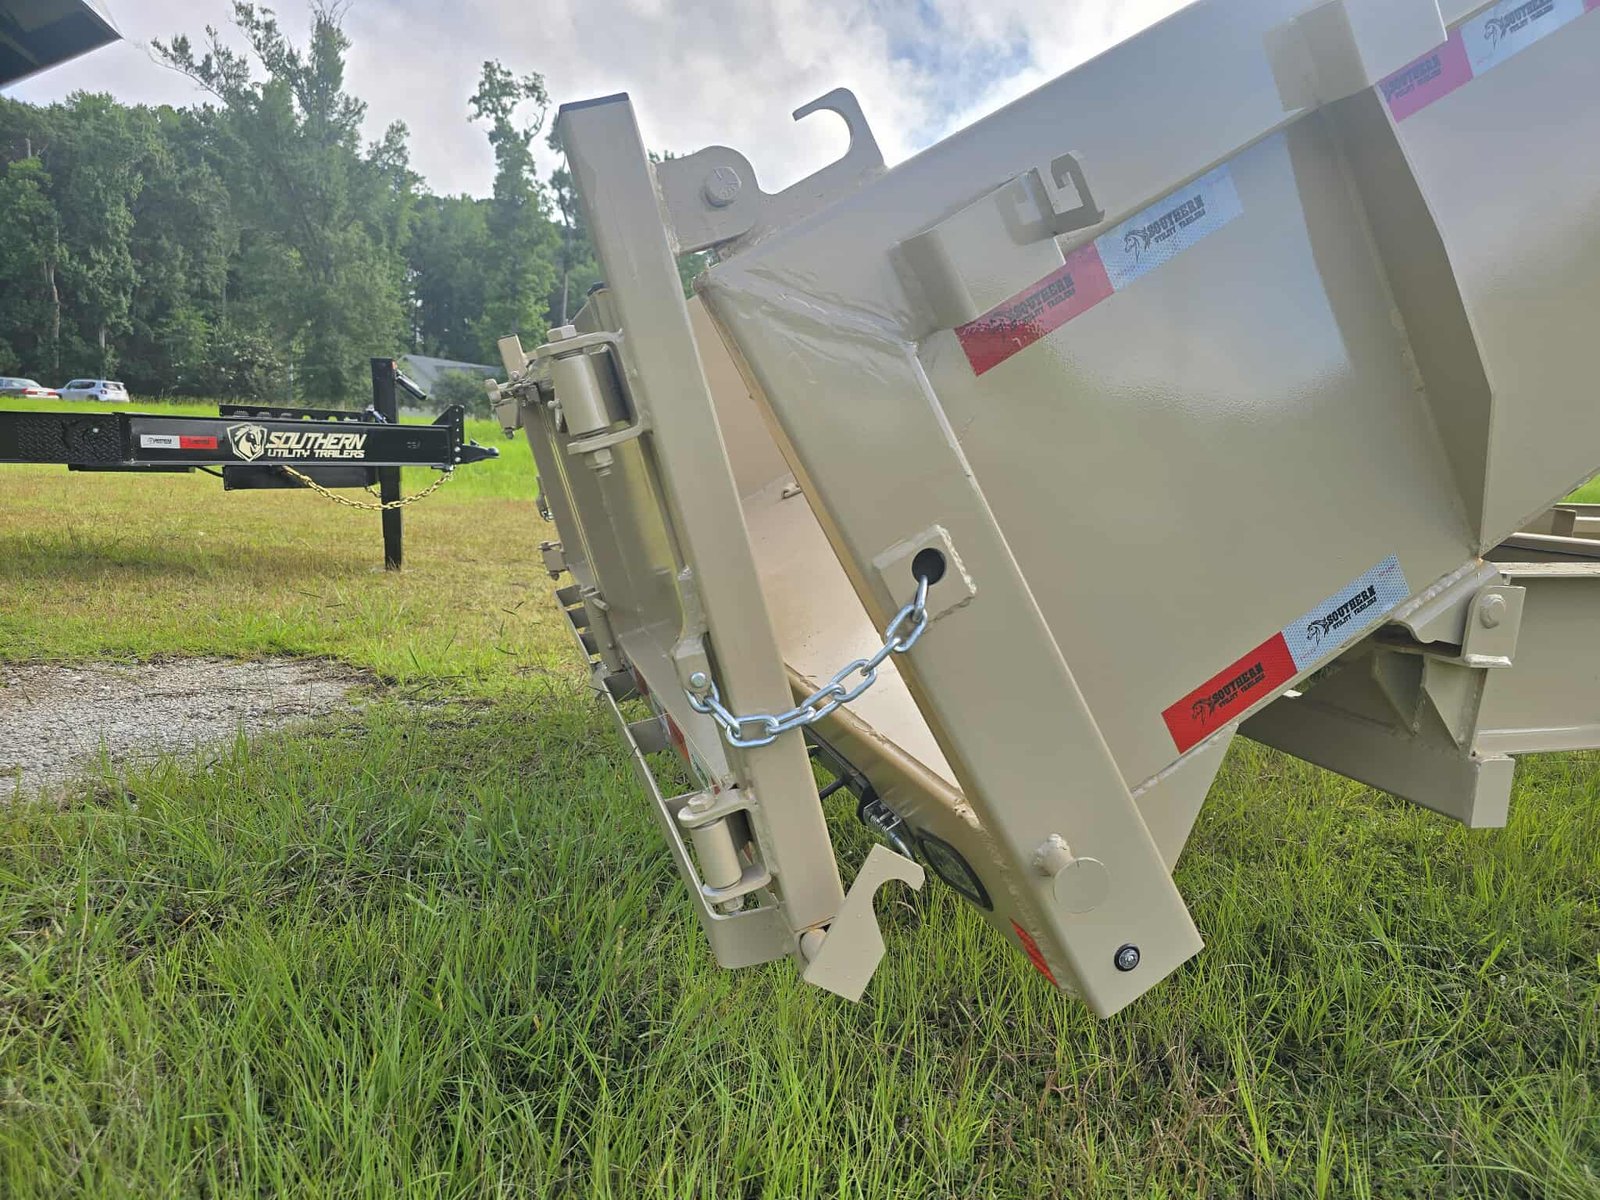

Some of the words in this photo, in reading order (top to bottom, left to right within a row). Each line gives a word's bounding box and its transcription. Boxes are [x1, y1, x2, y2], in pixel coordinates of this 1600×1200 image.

[265, 432, 367, 450] SOUTHERN
[267, 450, 311, 458] UTILITY
[314, 450, 365, 459] TRAILERS
[1325, 585, 1376, 627] SOUTHERN
[1211, 661, 1264, 702] SOUTHERN
